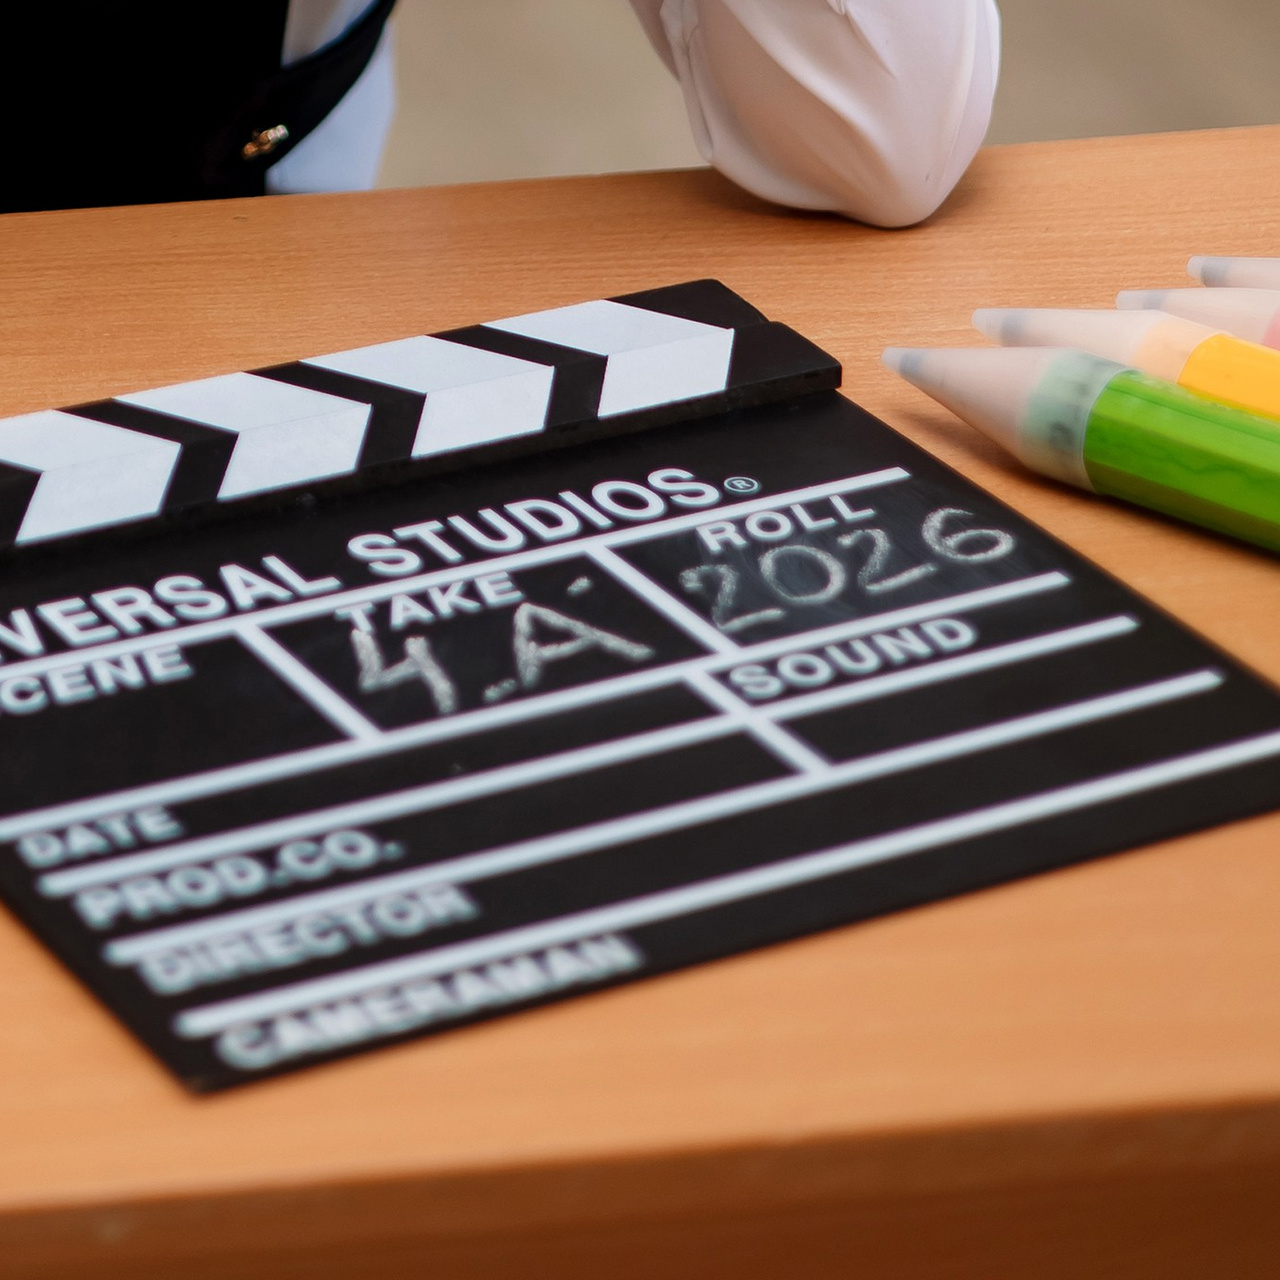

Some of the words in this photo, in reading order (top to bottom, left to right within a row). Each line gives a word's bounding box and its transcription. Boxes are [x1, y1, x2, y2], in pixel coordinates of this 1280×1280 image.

[694, 493, 877, 556] ROLL
[334, 570, 525, 632] TAKE
[678, 506, 1016, 634] 2026
[728, 618, 978, 700] SOUND
[17, 804, 184, 868] DATE
[136, 882, 480, 996] DIRECTOR
[216, 931, 646, 1071] CAMERAMAN
